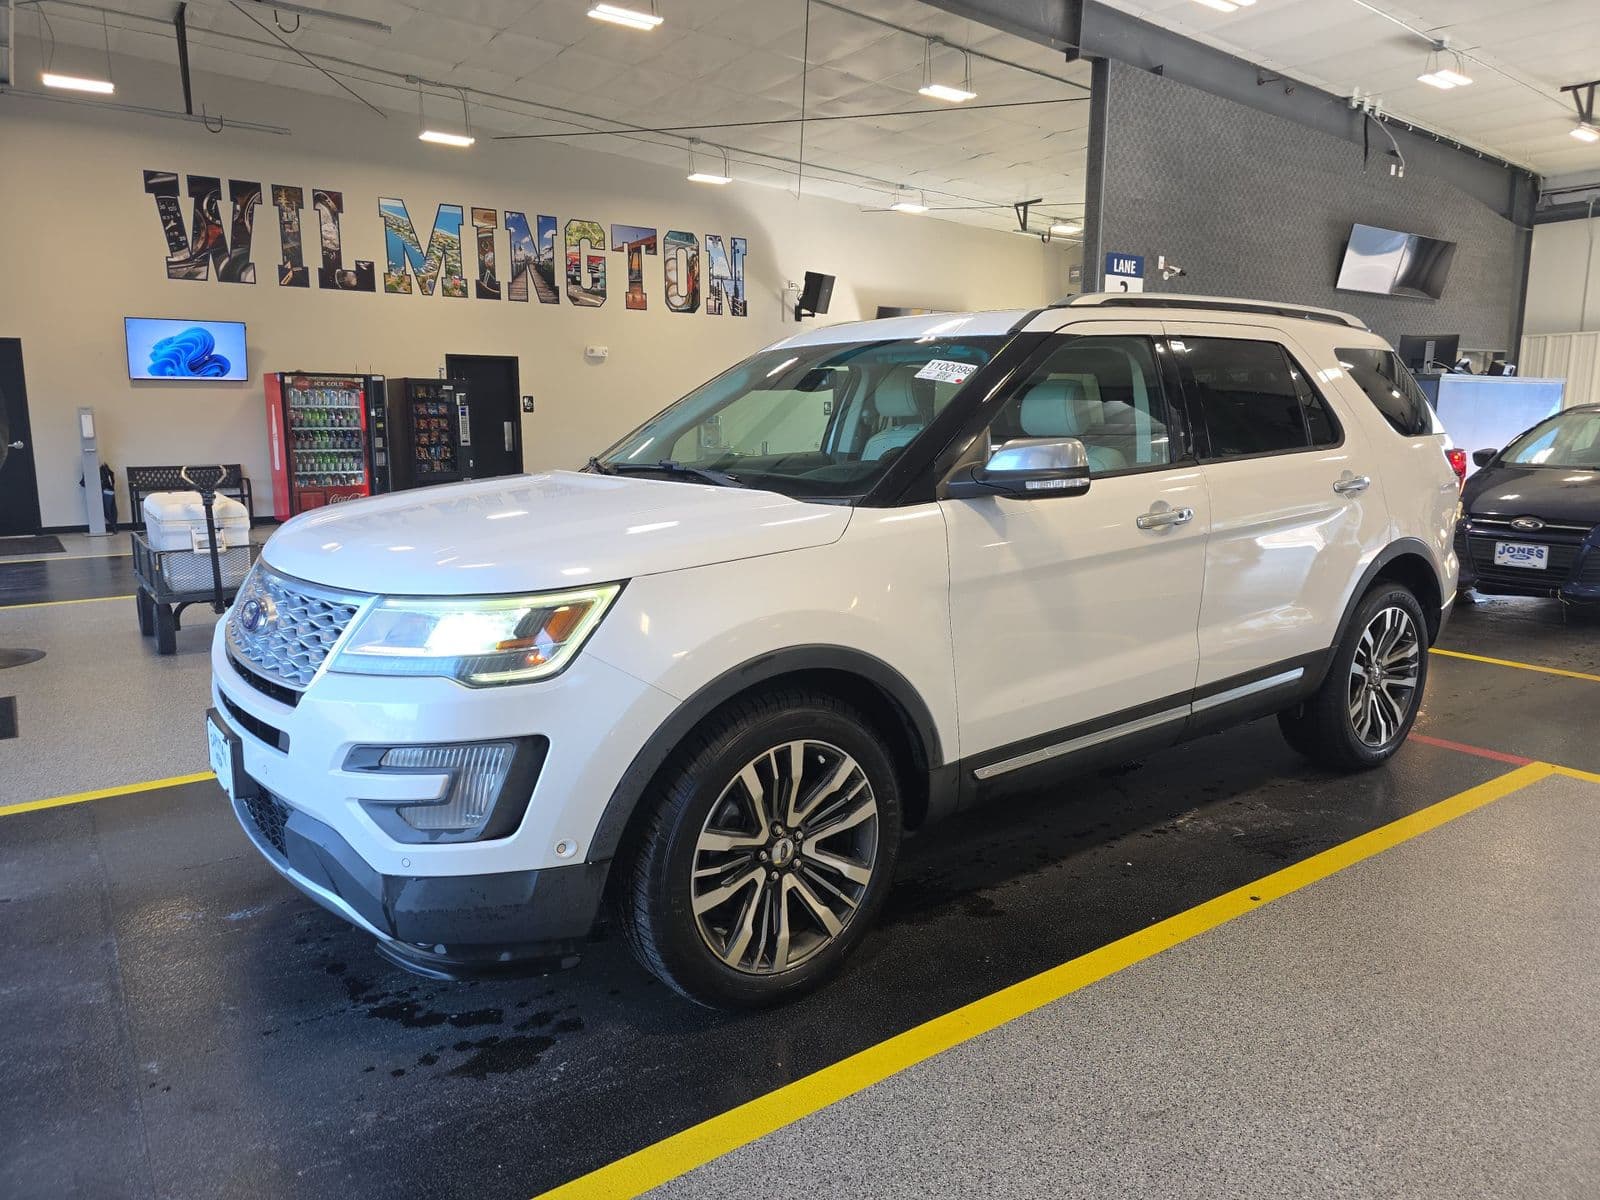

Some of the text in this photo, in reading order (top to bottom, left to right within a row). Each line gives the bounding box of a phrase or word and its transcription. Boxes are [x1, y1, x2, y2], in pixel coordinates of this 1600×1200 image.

[143, 170, 748, 317] WILMINGTON
[1113, 258, 1137, 274] LANE
[1498, 546, 1545, 560] JONES
